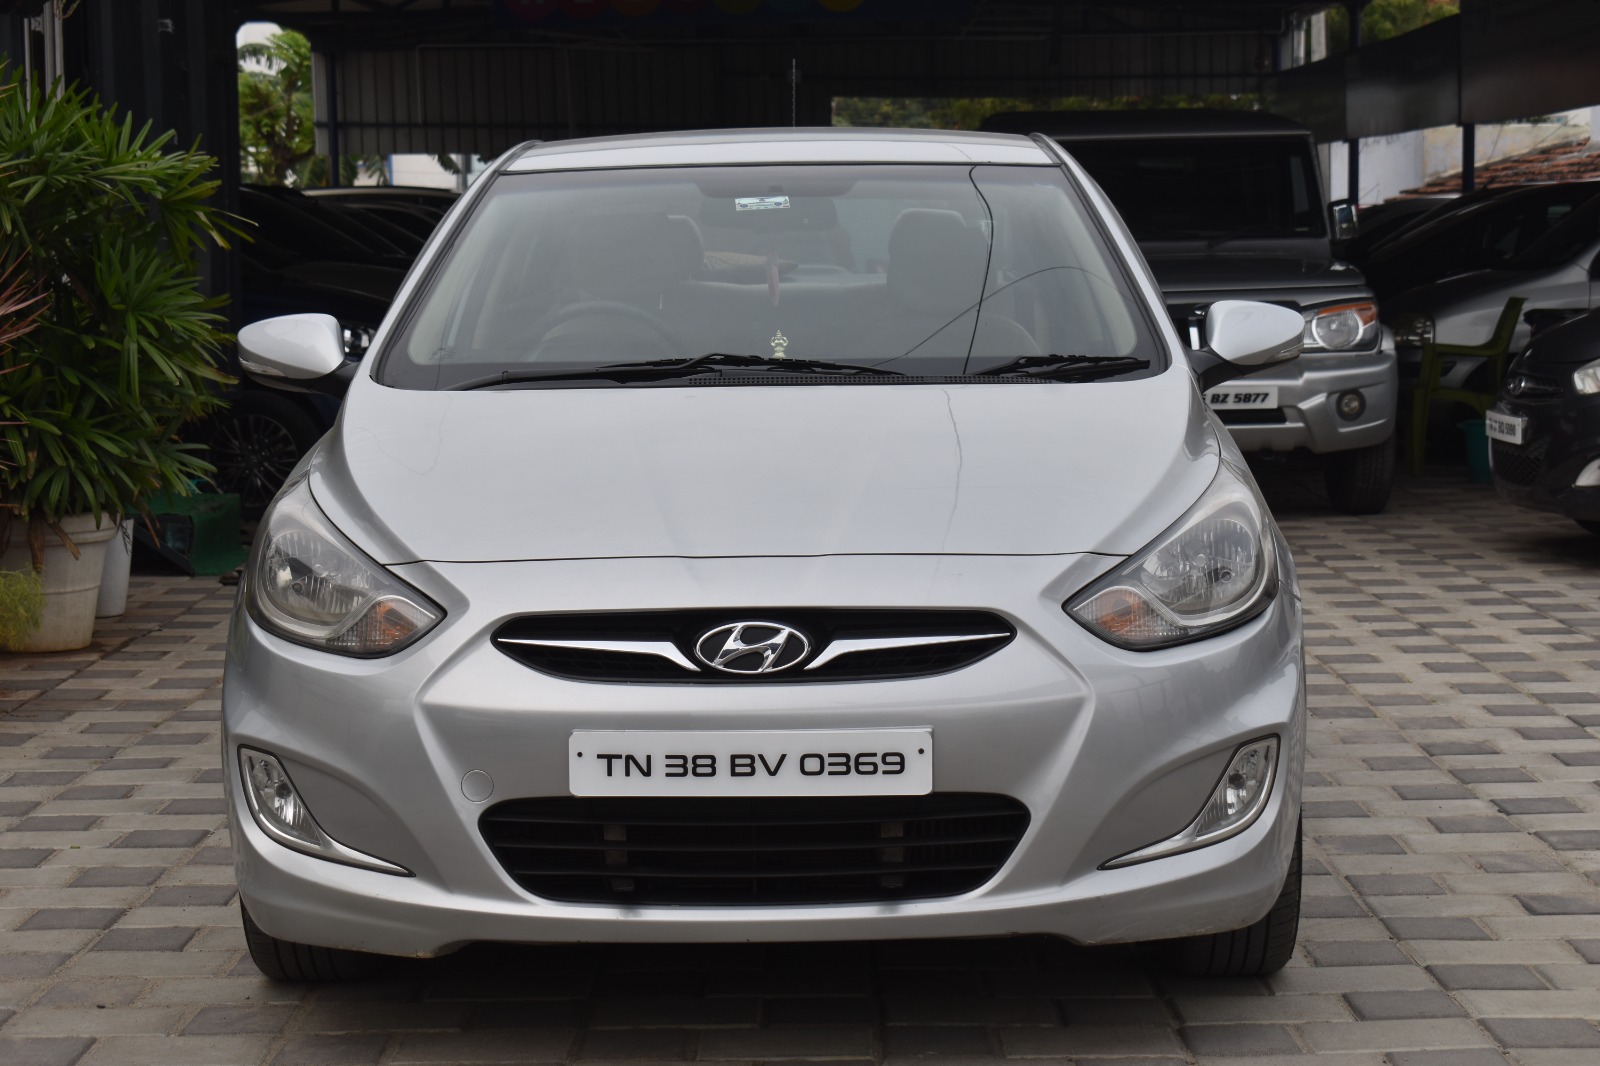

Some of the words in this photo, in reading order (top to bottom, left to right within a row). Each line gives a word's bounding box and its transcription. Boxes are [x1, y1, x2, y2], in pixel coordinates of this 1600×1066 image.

[1210, 393, 1230, 404] BZ
[1233, 392, 1269, 404] 5877
[596, 753, 652, 778] TN
[664, 754, 717, 778] 38
[729, 753, 788, 778] BV
[799, 751, 906, 777] 0369
